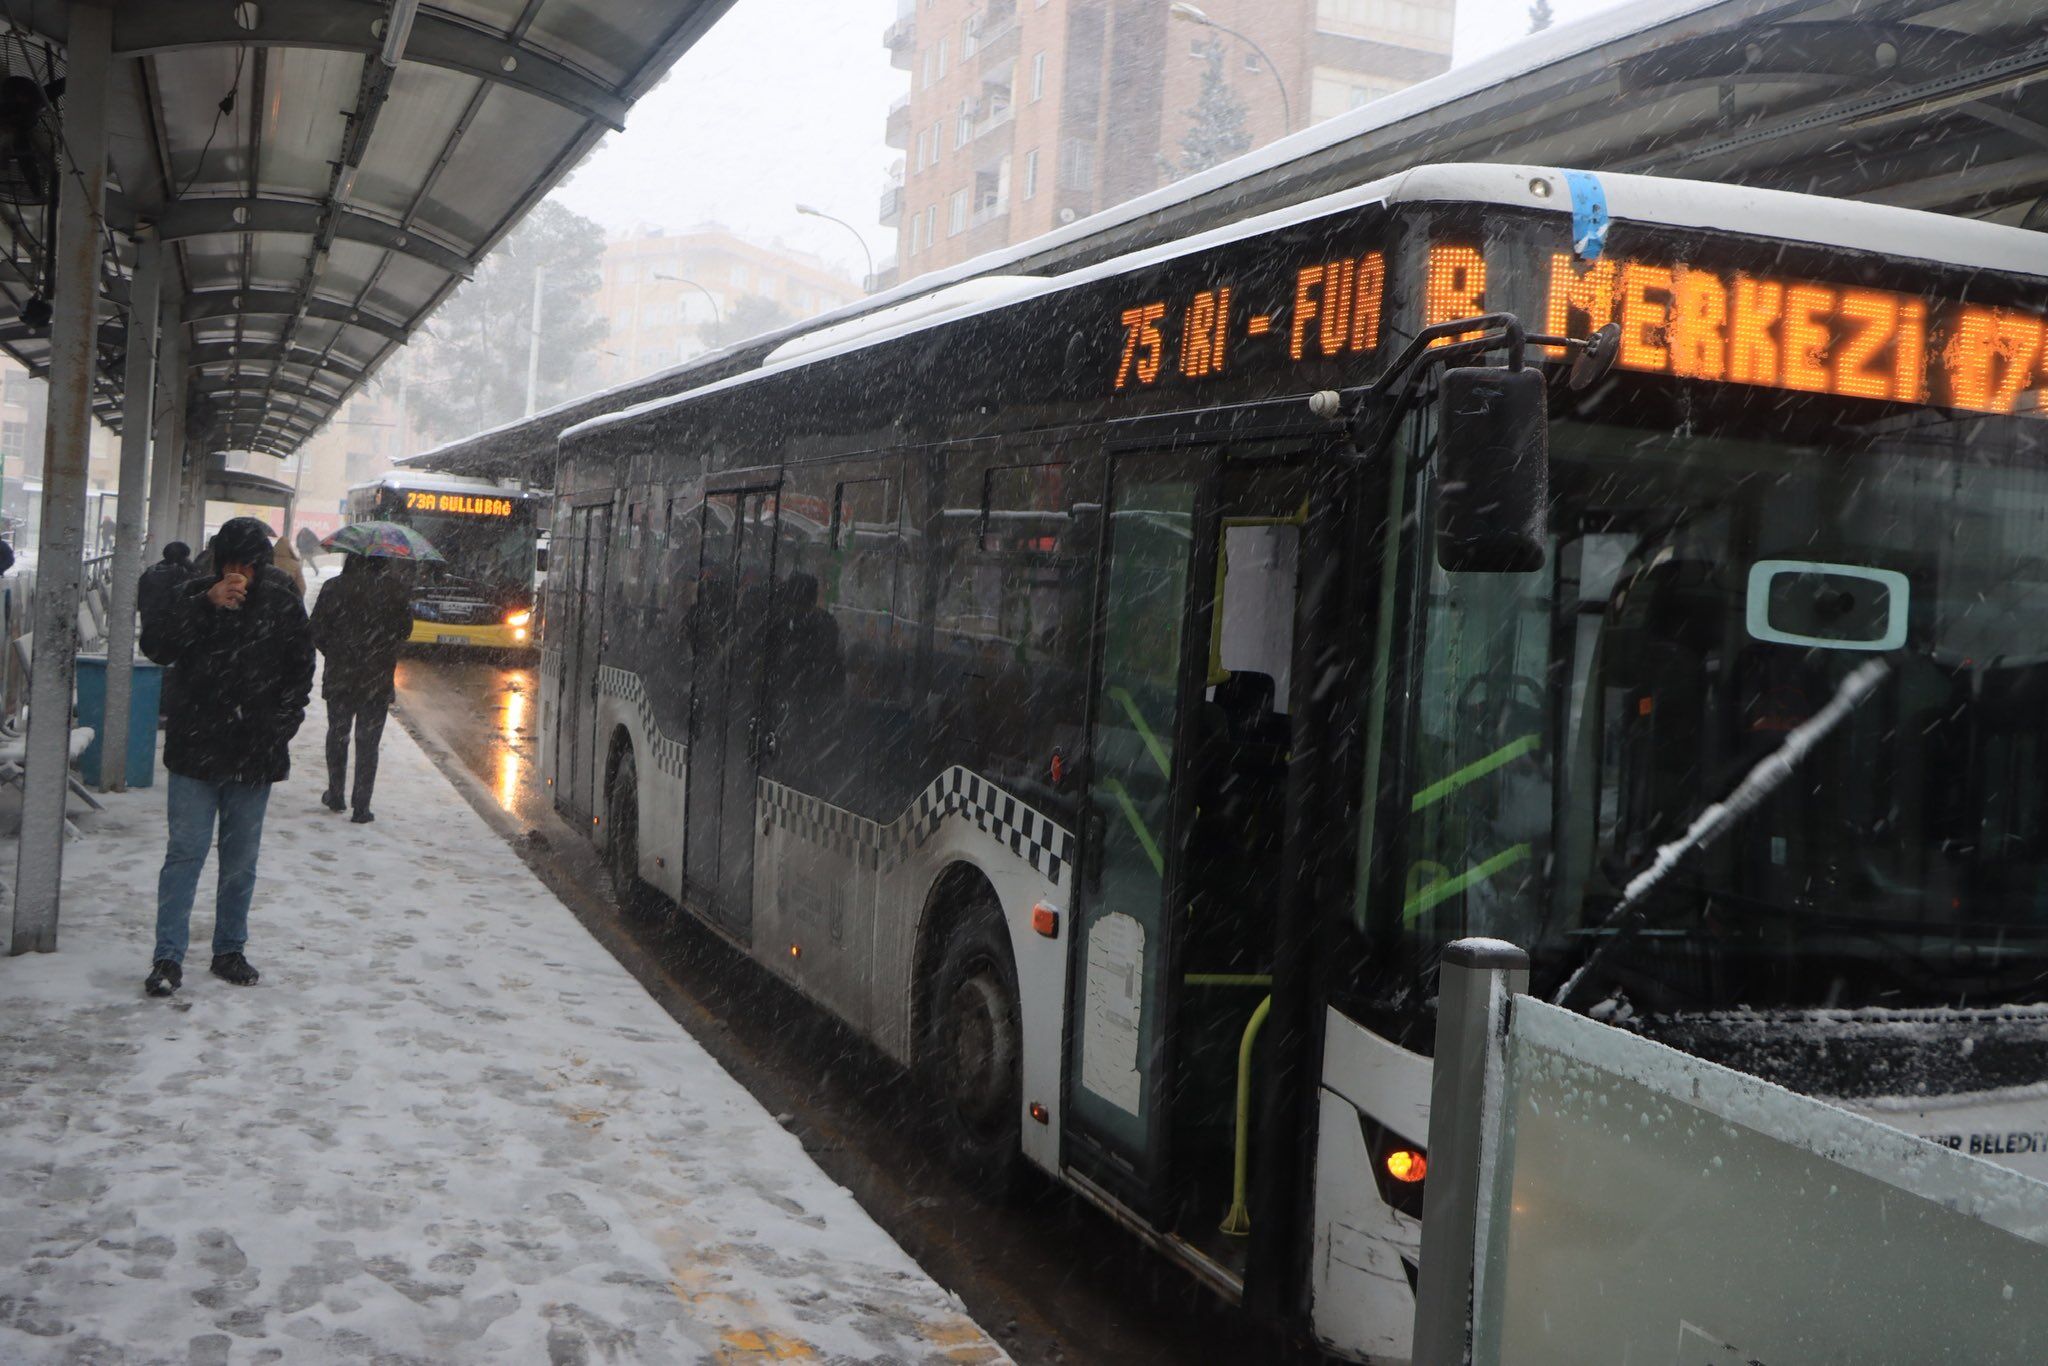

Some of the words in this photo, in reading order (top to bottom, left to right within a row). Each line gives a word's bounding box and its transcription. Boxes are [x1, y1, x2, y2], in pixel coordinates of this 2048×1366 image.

[1114, 302, 1165, 388] 75
[1290, 252, 1384, 360] FUA
[406, 492, 436, 510] 73A
